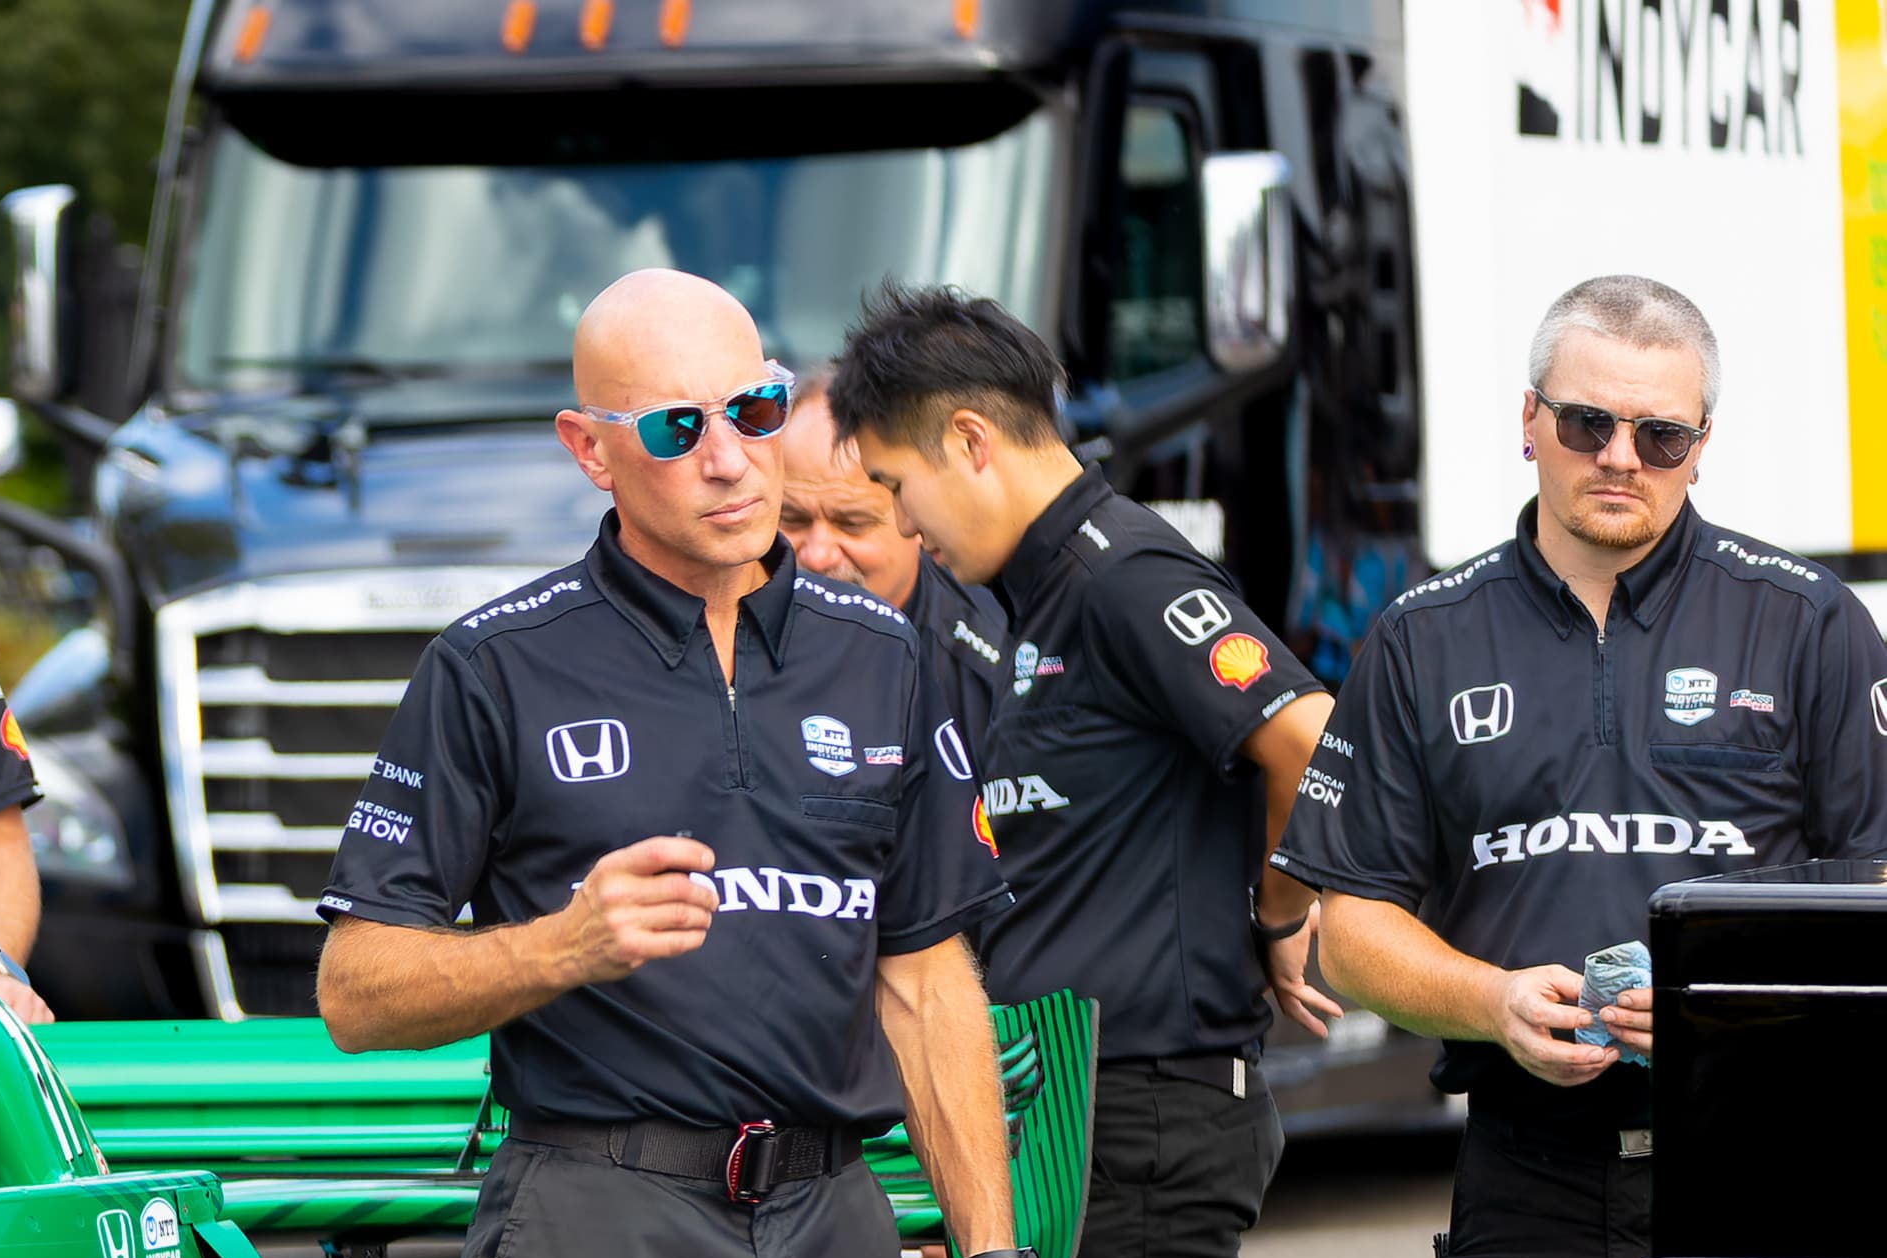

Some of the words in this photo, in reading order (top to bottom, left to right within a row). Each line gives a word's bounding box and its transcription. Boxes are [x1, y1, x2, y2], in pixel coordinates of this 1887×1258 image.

[1576, 0, 1804, 155] INDYCAR
[1394, 552, 1503, 606] Firestone
[1717, 539, 1822, 583] Firestone
[462, 578, 582, 629] Firestone
[794, 577, 905, 625] Firestone
[1664, 693, 1716, 705] INDYCAR
[806, 741, 853, 758] INDYCAR
[382, 761, 425, 790] BANK
[983, 774, 1071, 818] NDA
[347, 810, 410, 845] GION
[353, 799, 414, 827] MERICAN
[1472, 812, 1756, 872] HONDA
[688, 867, 877, 921] NDA
[158, 1218, 176, 1238] NTT
